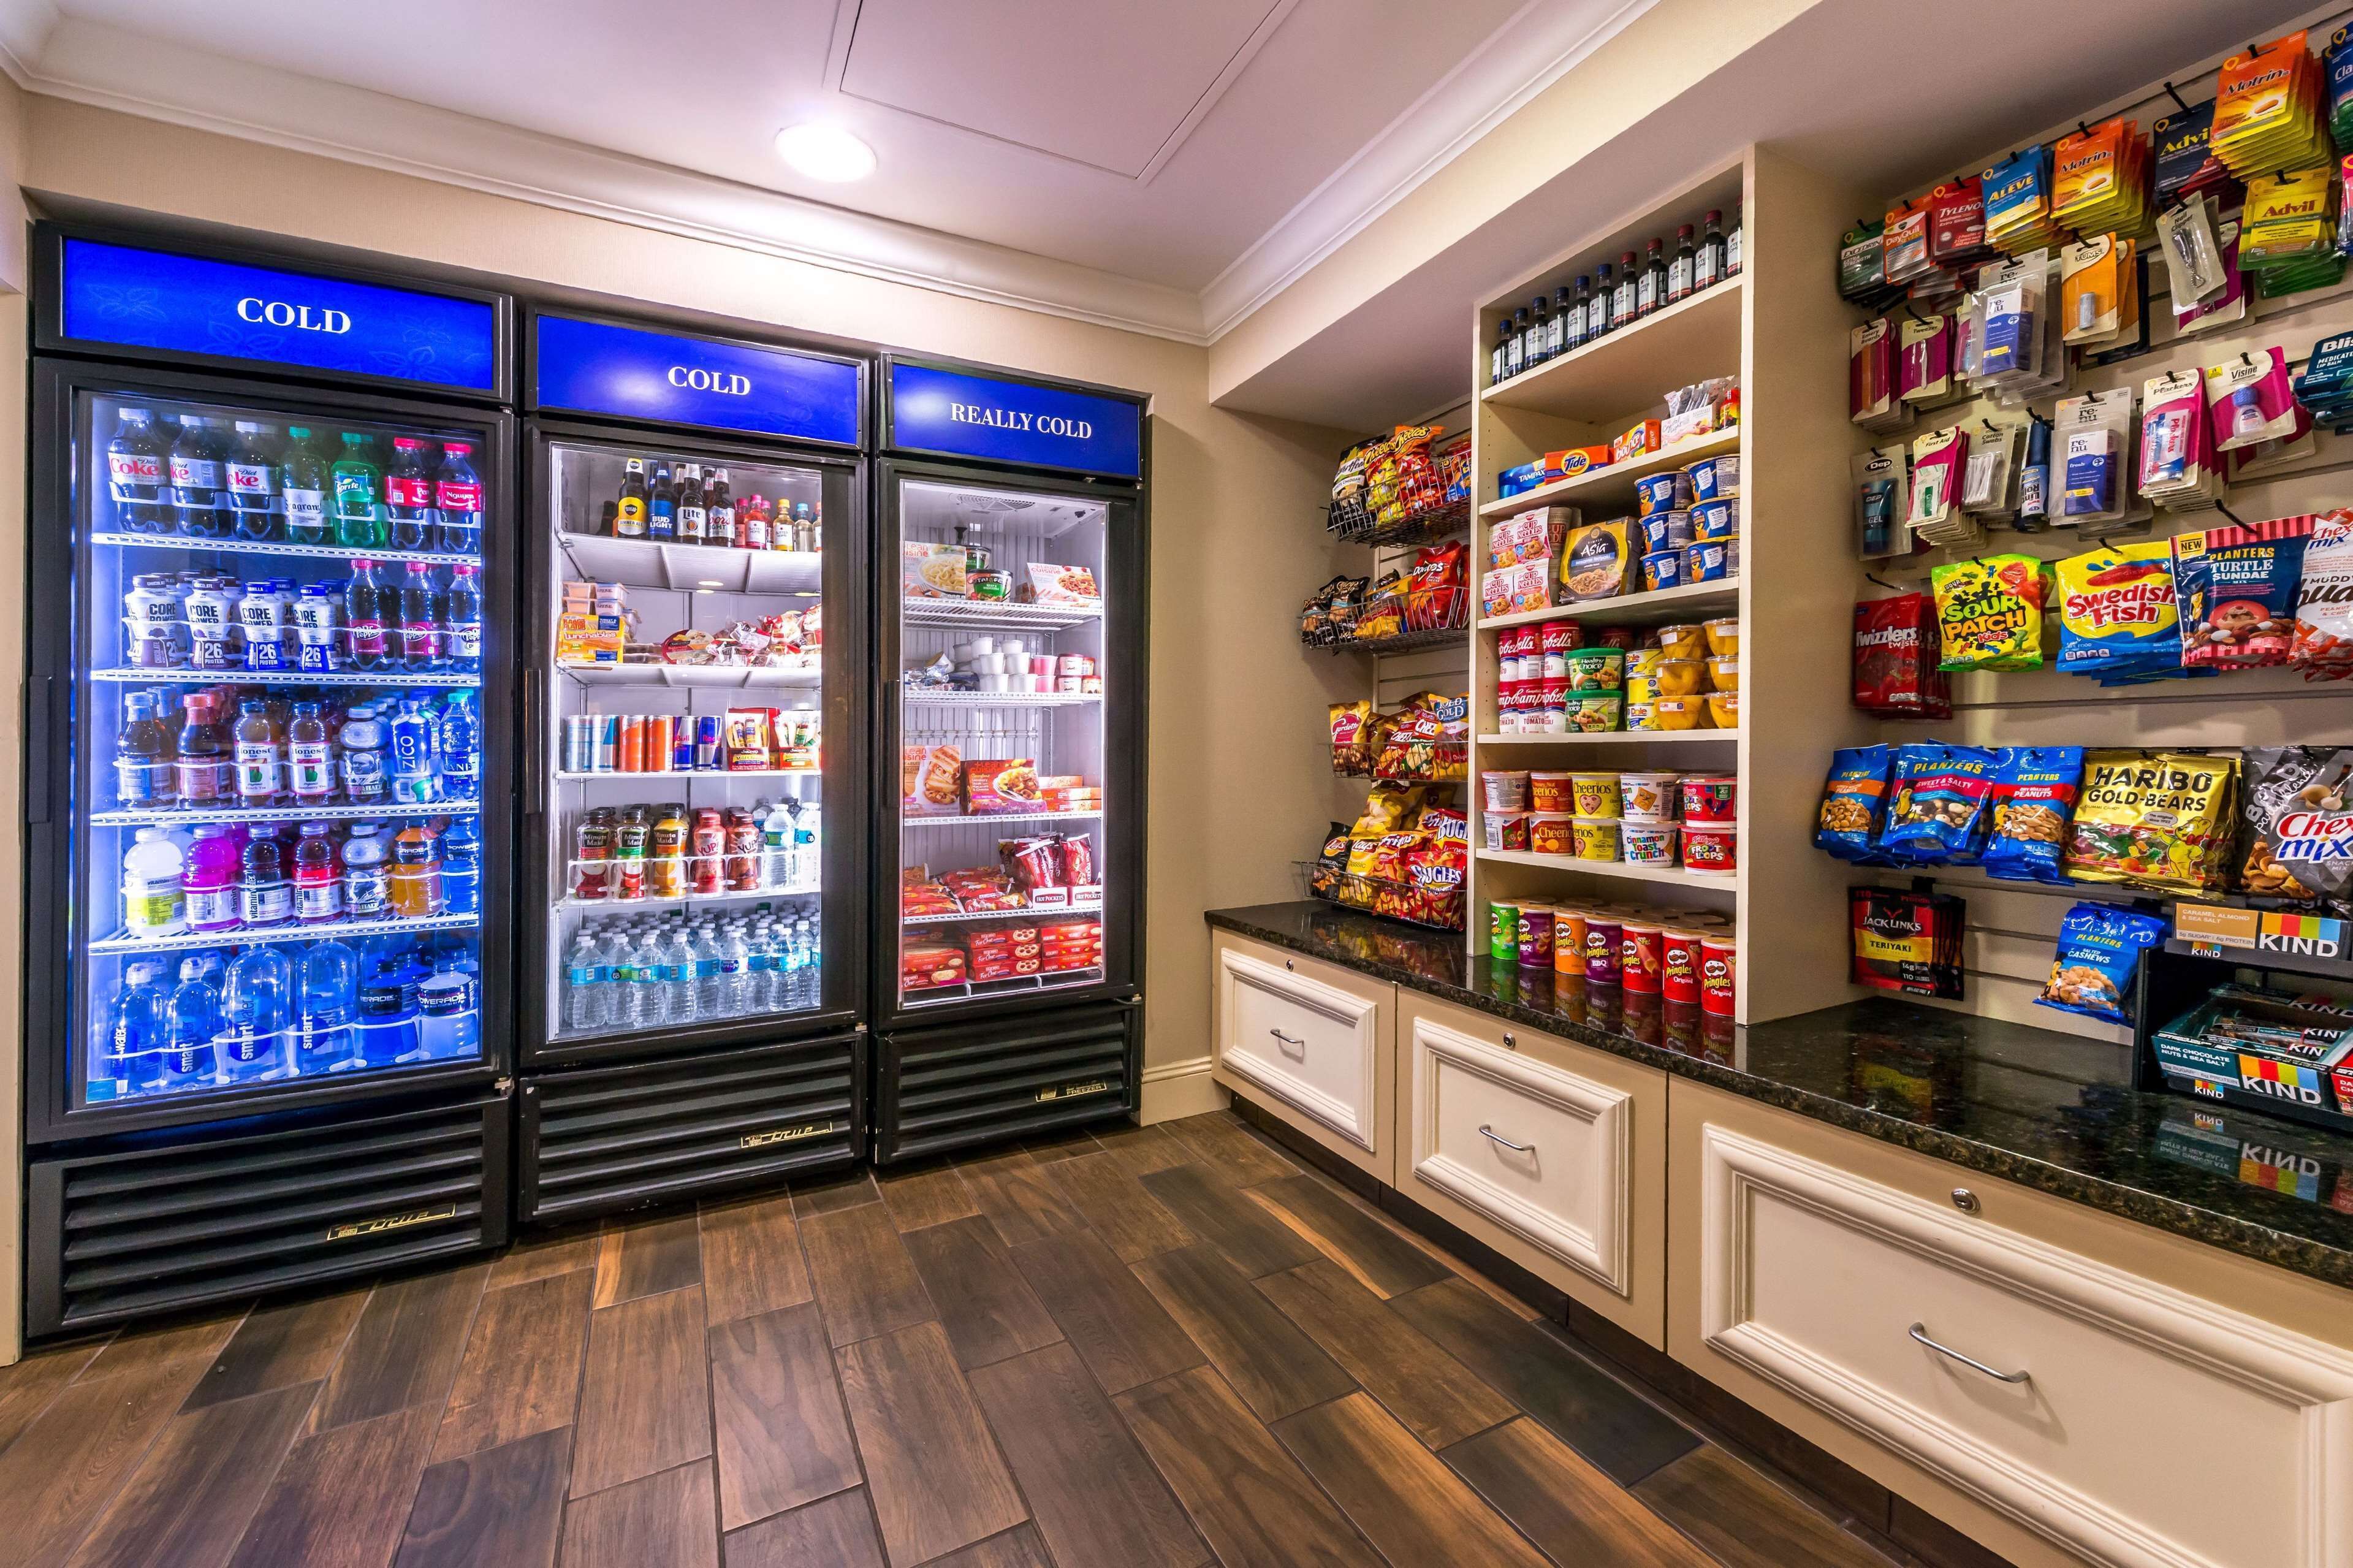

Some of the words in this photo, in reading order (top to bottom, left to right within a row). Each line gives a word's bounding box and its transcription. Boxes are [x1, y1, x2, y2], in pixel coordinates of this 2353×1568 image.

[2225, 69, 2283, 97] Motrin
[2060, 151, 2107, 175] Motrin
[1988, 174, 2034, 205] ALEVE
[2262, 200, 2316, 218] Advil
[2171, 215, 2193, 232] Clipper
[2174, 211, 2187, 223] Nail
[1886, 226, 1919, 246] DayQuil
[1844, 239, 1882, 257] EXCEDRIN
[2075, 249, 2102, 262] TUMS
[237, 297, 351, 335] COLD
[1861, 329, 1879, 339] Emery
[1912, 325, 1938, 333] Tweezer
[1861, 333, 1881, 344] Boards
[2231, 365, 2257, 379] Visine
[667, 367, 751, 395] COLD
[2153, 381, 2194, 395] Plackers
[951, 403, 1033, 430] REALLY
[1037, 416, 1092, 438] COLD
[1616, 433, 1640, 459] bounce
[2070, 444, 2088, 452] nu
[109, 458, 159, 476] Coke
[1564, 455, 1587, 473] Tide
[1869, 460, 1891, 469] Dep
[1519, 469, 1545, 482] TAMPAX
[336, 481, 359, 495] Sprite
[447, 491, 474, 500] Nguyen
[683, 509, 701, 520] Lite
[1868, 515, 1883, 523] GEL
[1522, 520, 1537, 530] CUP
[1497, 531, 1510, 541] CUP
[1517, 526, 1543, 539] NOODLES
[2181, 539, 2202, 552] NEW
[2309, 533, 2349, 549] mix
[1581, 542, 1606, 557] Asia
[2210, 547, 2275, 561] PLANTERS
[2211, 559, 2273, 573] TURTLE
[1523, 571, 1538, 580] CUP
[2213, 571, 2270, 580] SUNDAE
[1489, 579, 1504, 589] CUP
[1518, 577, 1543, 589] NOODLES
[1485, 585, 1508, 596] NOODLES
[189, 606, 217, 617] CORE
[242, 607, 271, 620] CORE
[1945, 595, 2018, 622] SOUR
[2091, 603, 2159, 628] Fish
[1944, 611, 2024, 640] PATCH
[563, 631, 616, 640] Lunchables
[1977, 631, 2008, 642] Kids
[1889, 639, 1920, 648] twists
[205, 643, 222, 659] 26
[259, 644, 276, 659] 26
[305, 647, 321, 661] 26
[1437, 706, 1464, 720] GOLD
[1630, 707, 1647, 716] Dole
[400, 736, 416, 768] ZICO
[1914, 761, 1984, 775] PLANTERS
[1916, 778, 1939, 788] SWEET
[1946, 778, 1974, 789] SALTY
[2018, 773, 2060, 782] PLANTERS
[2094, 767, 2213, 793] HARIBO
[1574, 783, 1611, 794] Cheerios
[2088, 789, 2207, 812] GOLD-BEARS
[1627, 835, 1664, 843] Cinnamon
[1692, 835, 1720, 843] Kellogg's
[1630, 848, 1664, 860] Crunch
[1632, 842, 1657, 852] Toast
[2278, 835, 2353, 861] mix
[1696, 852, 1724, 861] LOOPS
[1410, 865, 1461, 884] BUGLES
[2183, 909, 2216, 918] CARAMEL
[1863, 916, 1890, 928] JACK
[1890, 919, 1922, 931] LINK'S
[1870, 941, 1911, 952] TERIYAKI
[2076, 934, 2123, 949] PLANTERS
[2259, 933, 2338, 957] KIND
[1587, 948, 1609, 959] Pringles
[2067, 950, 2111, 964] CASHEWS
[2191, 948, 2221, 957] KIND
[1667, 964, 1692, 978] Pringles
[1705, 976, 1730, 991] Pringles
[303, 1015, 313, 1049] smart
[2160, 1044, 2183, 1052] DARK
[2184, 1048, 2230, 1062] CHOCOLATE
[2161, 1049, 2181, 1057] NUTS
[1067, 1085, 1101, 1095] FREEZER
[2194, 1086, 2224, 1098] KIND
[2241, 1075, 2321, 1105] KIND
